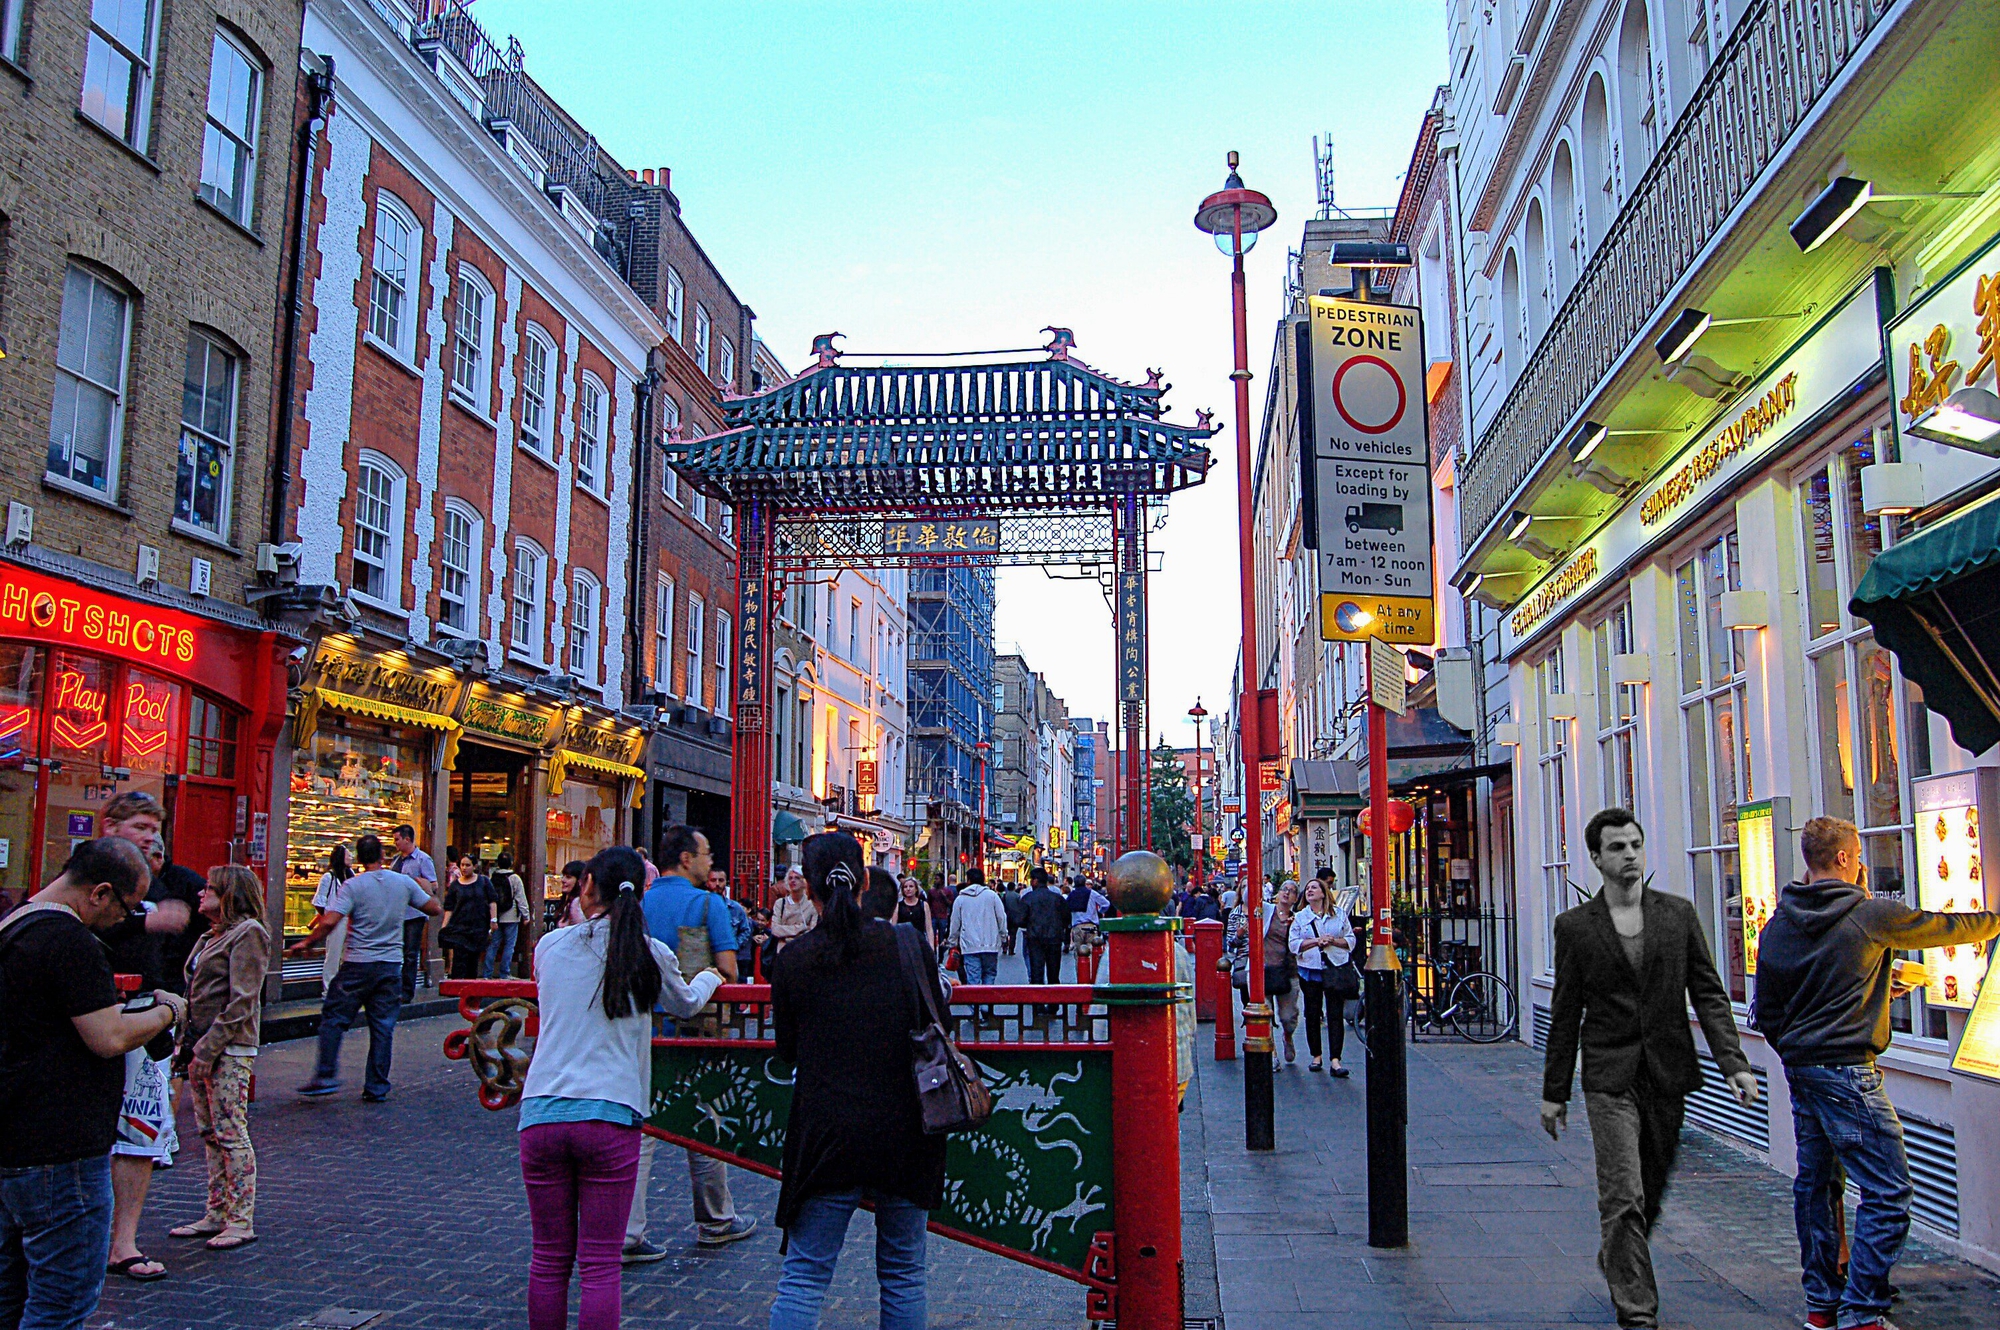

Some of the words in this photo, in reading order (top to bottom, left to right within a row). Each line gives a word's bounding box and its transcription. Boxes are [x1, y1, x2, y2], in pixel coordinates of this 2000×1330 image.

[1317, 307, 1414, 327] PEDESTRIAN
[1331, 326, 1402, 351] ZONE
[1330, 437, 1350, 451] No
[1355, 440, 1412, 456] vehicles
[1335, 464, 1384, 481] Except
[1389, 468, 1409, 482] for
[1336, 481, 1388, 500] loading
[1393, 486, 1409, 501] by
[1345, 537, 1405, 553] between
[1326, 553, 1357, 567] 7am
[1371, 556, 1386, 569] 12
[1391, 560, 1425, 571] noon
[1341, 571, 1372, 585] Mon
[1384, 573, 1411, 587] Sun
[1376, 604, 1392, 617] At
[1397, 608, 1421, 621] any
[1384, 622, 1415, 635] time
[58, 672, 106, 721] Play
[126, 683, 171, 722] Pool
